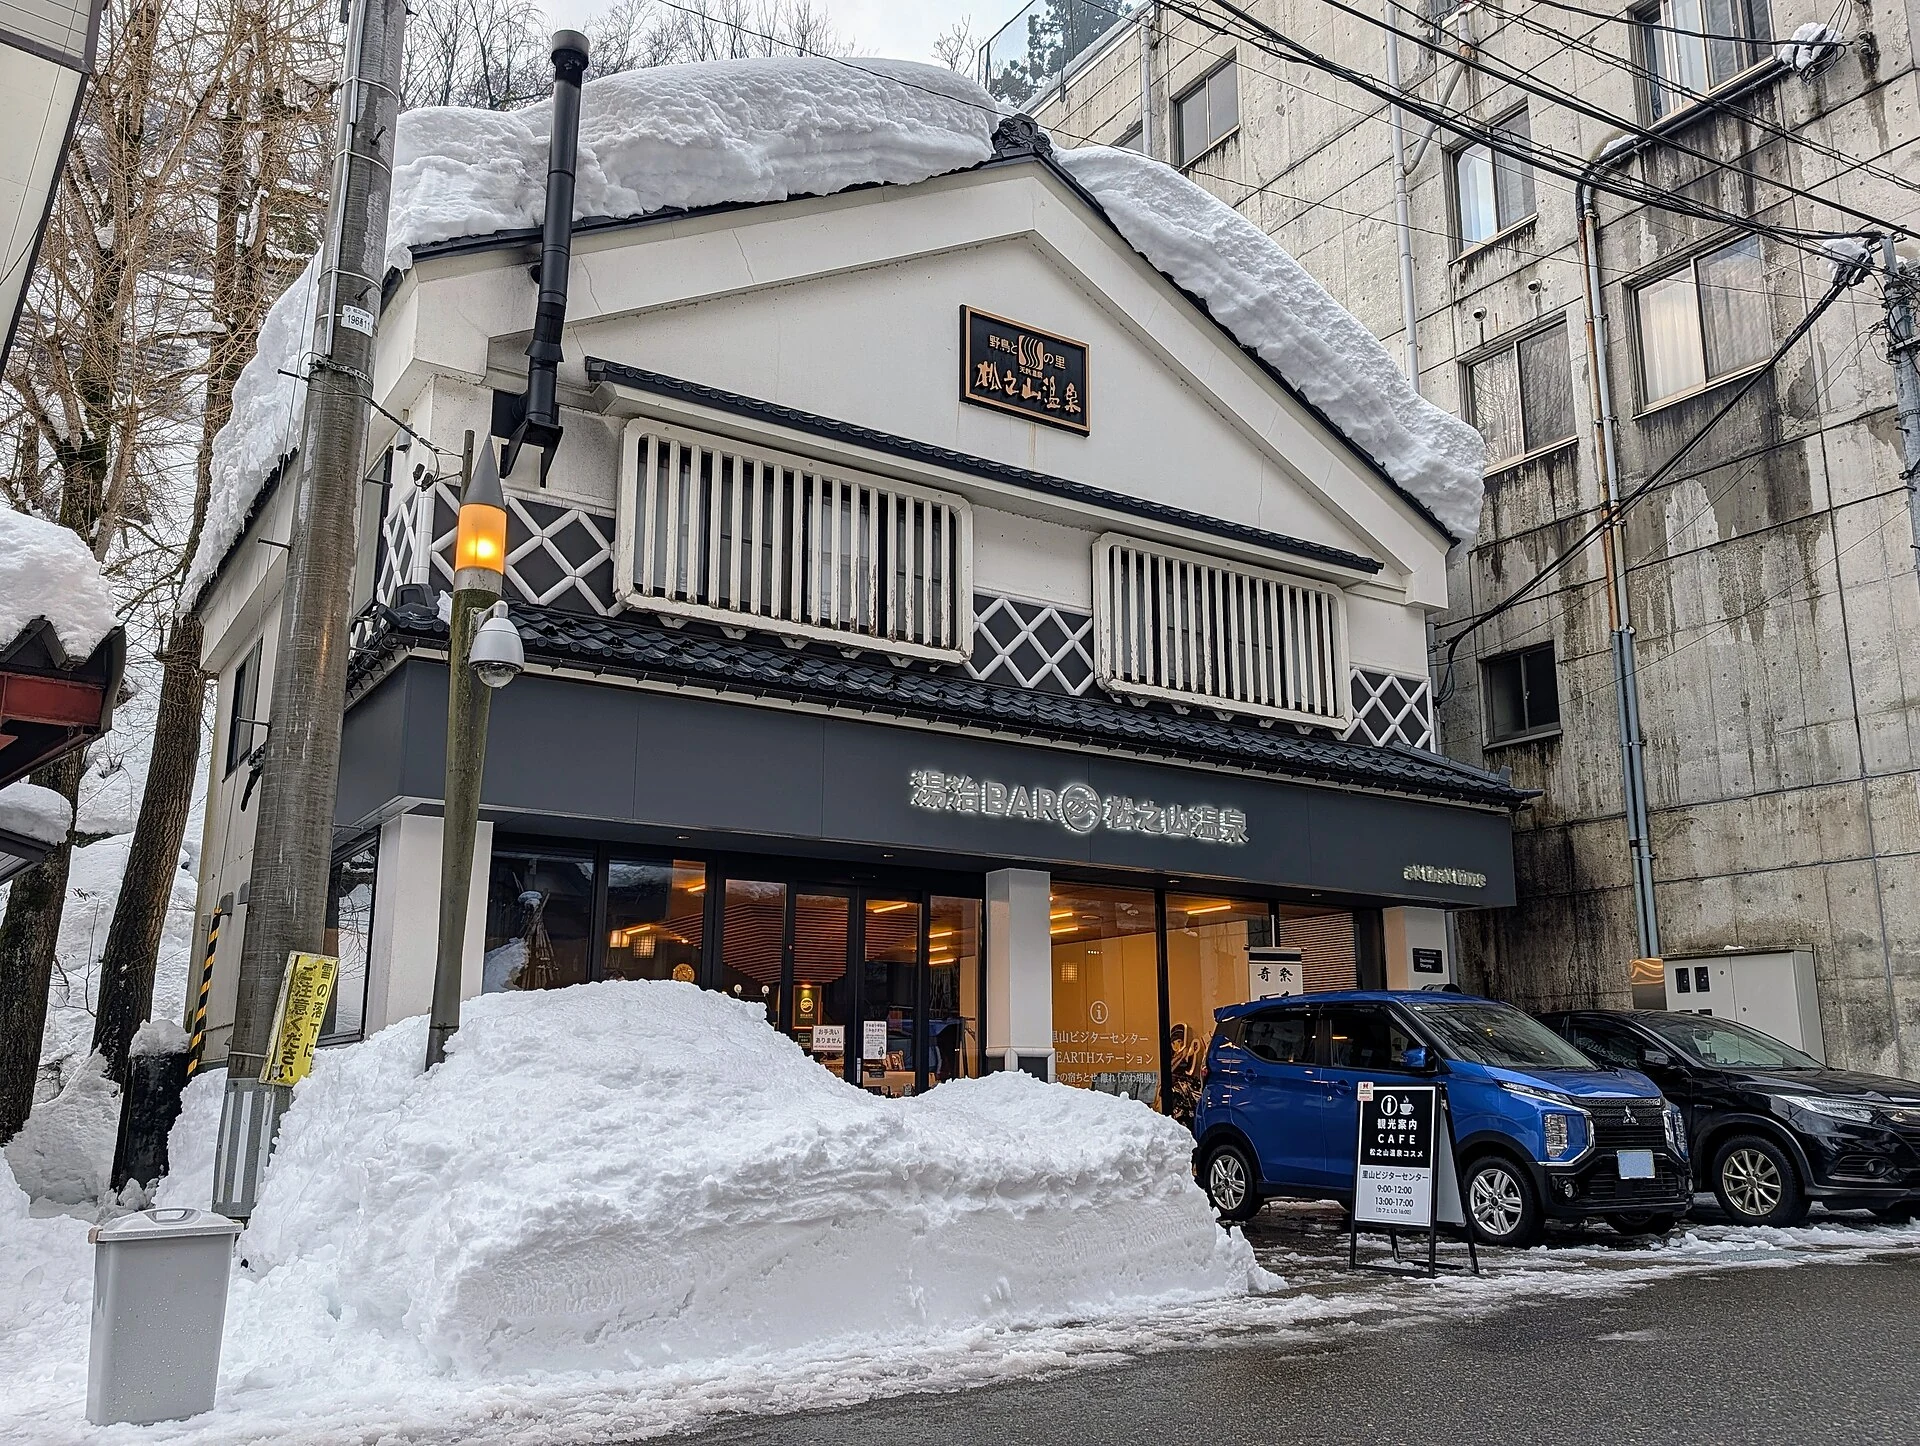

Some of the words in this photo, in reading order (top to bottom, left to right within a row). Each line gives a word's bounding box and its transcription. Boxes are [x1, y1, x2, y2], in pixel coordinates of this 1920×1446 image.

[975, 361, 1081, 413] 松之山温泉
[910, 770, 1060, 821] 湯治BAR
[1104, 795, 1250, 844] 松之山温泉
[303, 962, 333, 1058] 雪の落下に
[279, 964, 317, 1079] ご注意ください
[818, 1028, 840, 1036] お手洗い
[1377, 1118, 1418, 1131] 観光案内
[1377, 1134, 1416, 1145] CAFE
[1369, 1148, 1424, 1158] 松之山温泉コスメ
[1362, 1170, 1429, 1182] 里山ビジターセンター
[1377, 1184, 1412, 1195] 9:00-12:00
[1375, 1196, 1414, 1208] 13:00-17:00
